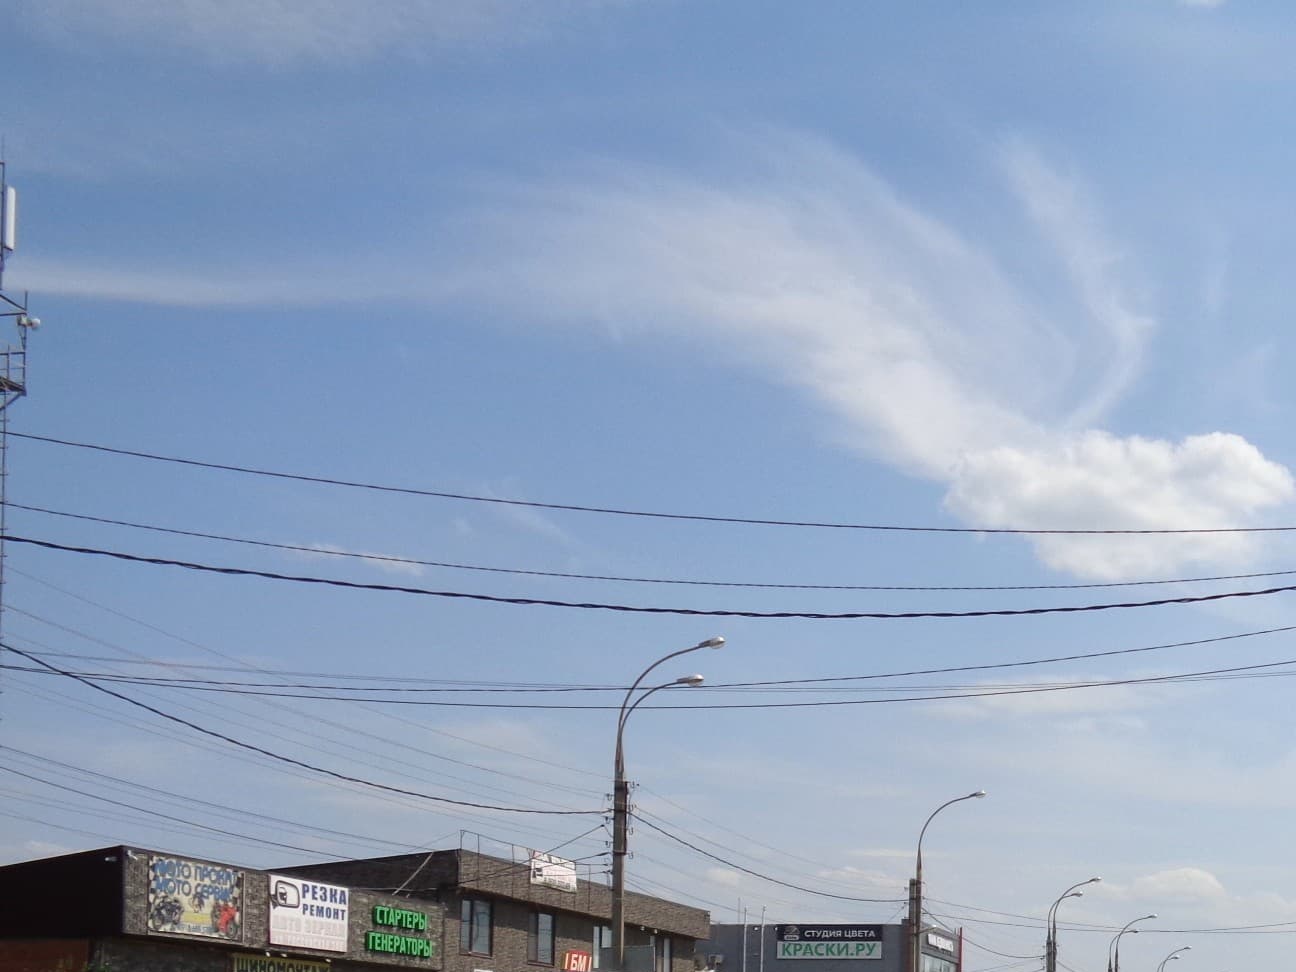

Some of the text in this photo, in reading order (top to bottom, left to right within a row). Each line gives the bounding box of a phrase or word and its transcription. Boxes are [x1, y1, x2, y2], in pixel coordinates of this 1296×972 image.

[302, 884, 347, 905] РЕЗКА
[302, 904, 346, 921] РЕМОНТ
[375, 905, 428, 930] СТАРТЕРЫ
[804, 929, 876, 939] СТУДИЯ ЦВЕТА
[368, 932, 433, 957] ГЕНЕРАТОРЫ
[782, 942, 877, 957] КРАСКИ.РУ
